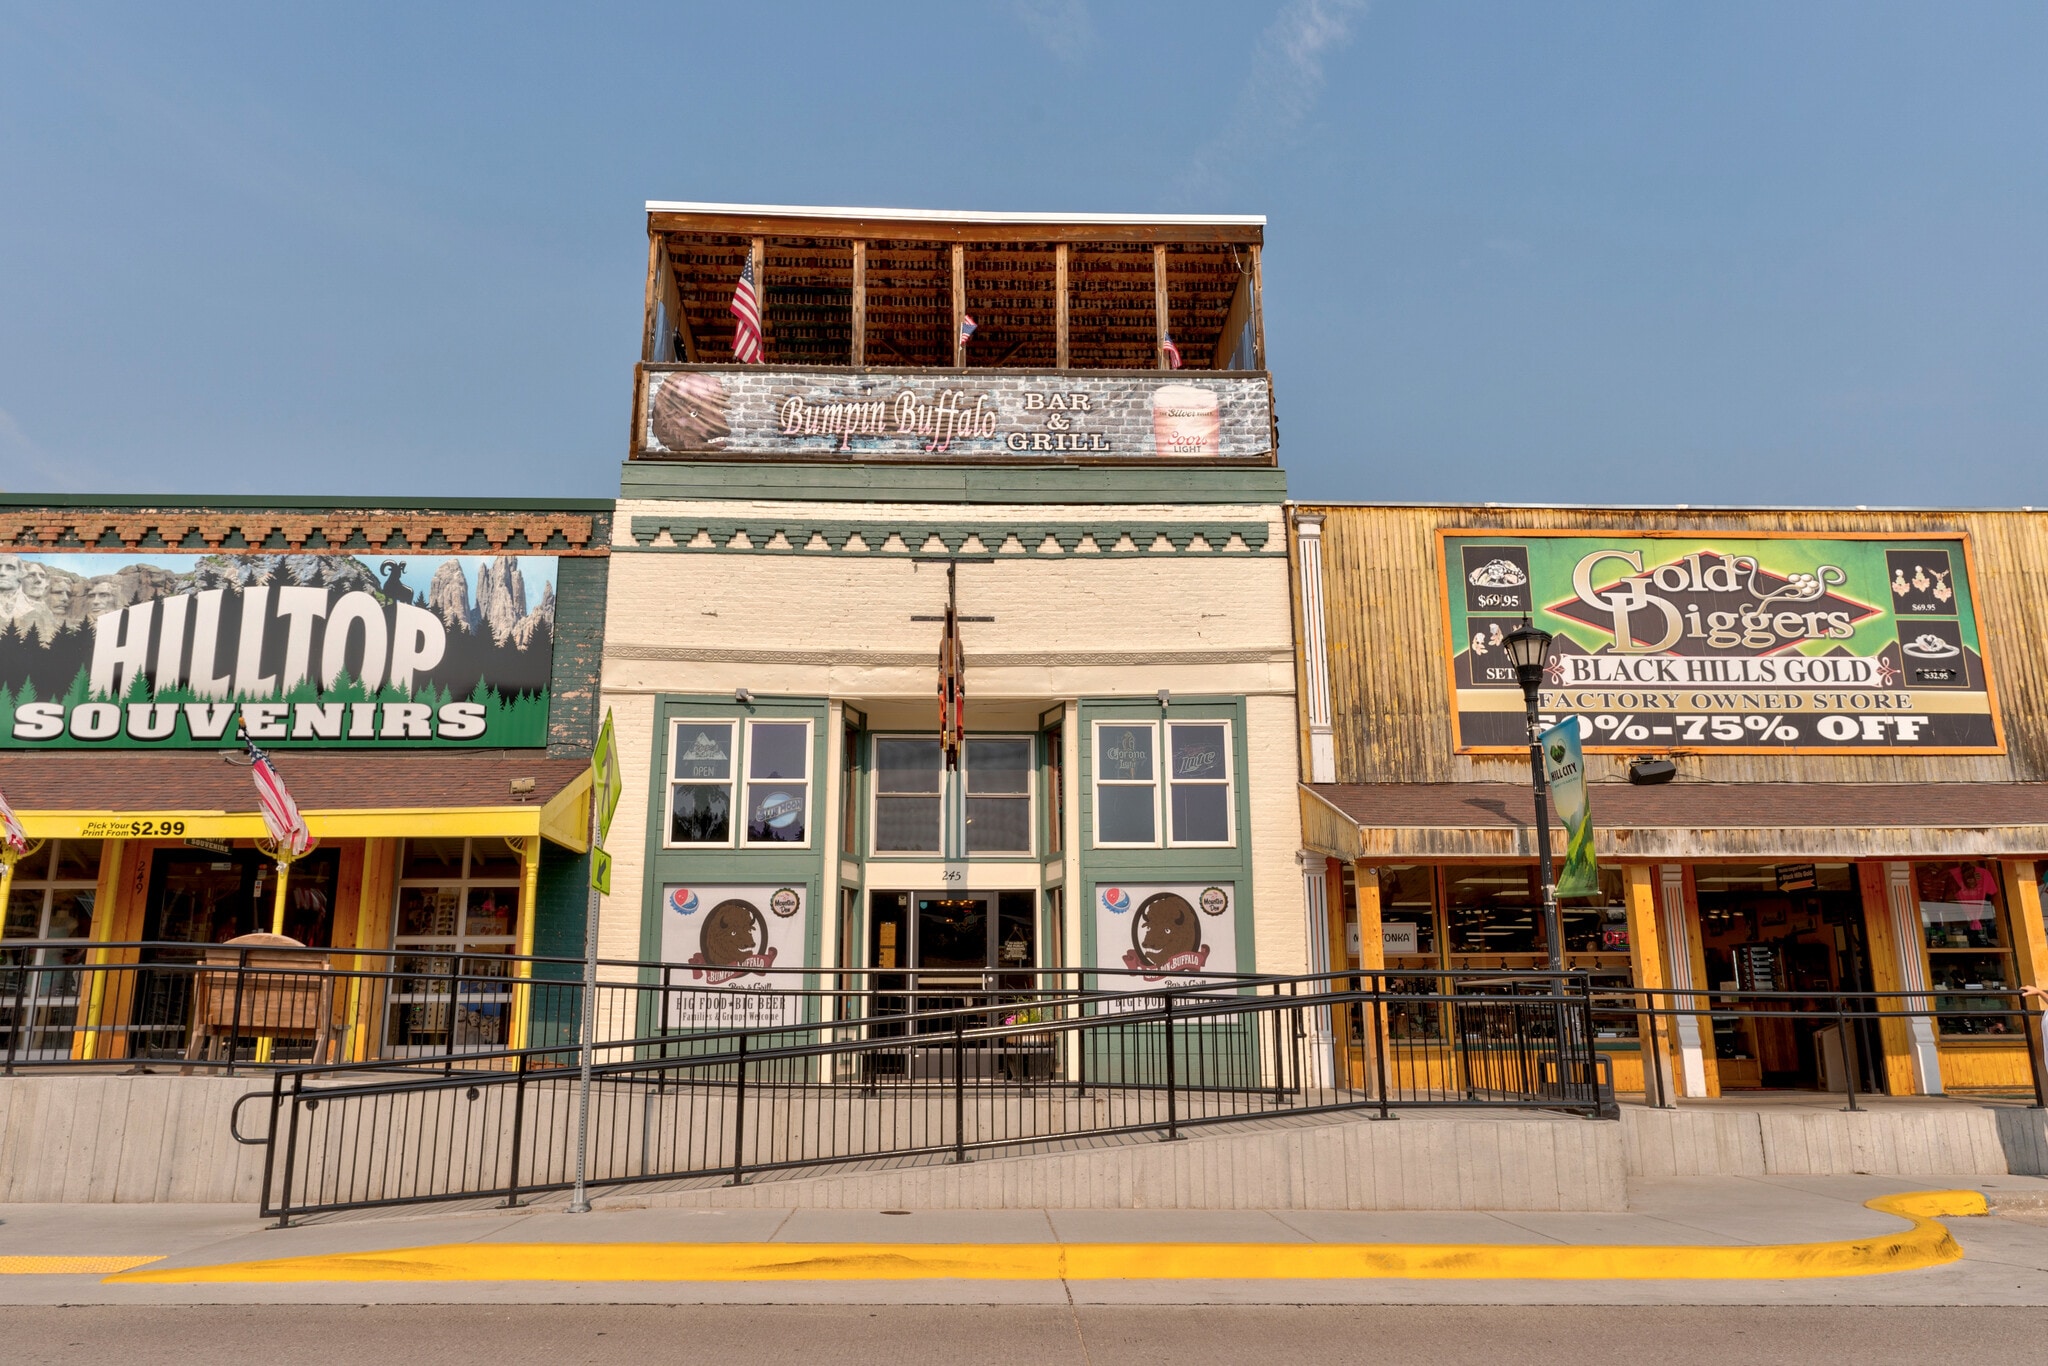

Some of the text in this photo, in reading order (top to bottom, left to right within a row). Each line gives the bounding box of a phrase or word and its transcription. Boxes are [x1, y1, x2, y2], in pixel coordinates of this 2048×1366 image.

[1024, 392, 1091, 411] BAR
[781, 388, 996, 452] Bumpin Buffalo
[1046, 412, 1070, 430] &
[1168, 408, 1195, 418] Silver
[1007, 432, 1110, 451] GRILL
[1167, 431, 1208, 446] Coors
[1173, 445, 1202, 453] LIGHT
[1572, 550, 1743, 612] Gold
[1478, 594, 1519, 608] $69.95
[1911, 603, 1936, 612] $69.95
[1600, 592, 1855, 654] Diggers
[88, 585, 447, 704] HILLTOP
[1571, 658, 1872, 683] BLACK HILLS GOLD
[1924, 671, 1949, 681] $32.95
[1538, 692, 1913, 709] FACTORY OWNED STORE
[12, 701, 488, 742] SOUVENIRS
[1816, 714, 1930, 741] OFF
[693, 766, 715, 777] OPEN
[1551, 768, 1563, 782] HILL
[1562, 762, 1578, 777] CITY
[131, 821, 185, 836] $2.99
[191, 838, 229, 853] SOUVENIRS
[942, 871, 961, 881] 245
[1171, 954, 1199, 970] BUFFALO
[676, 997, 785, 1010] BIG FOOD BIG BEER
